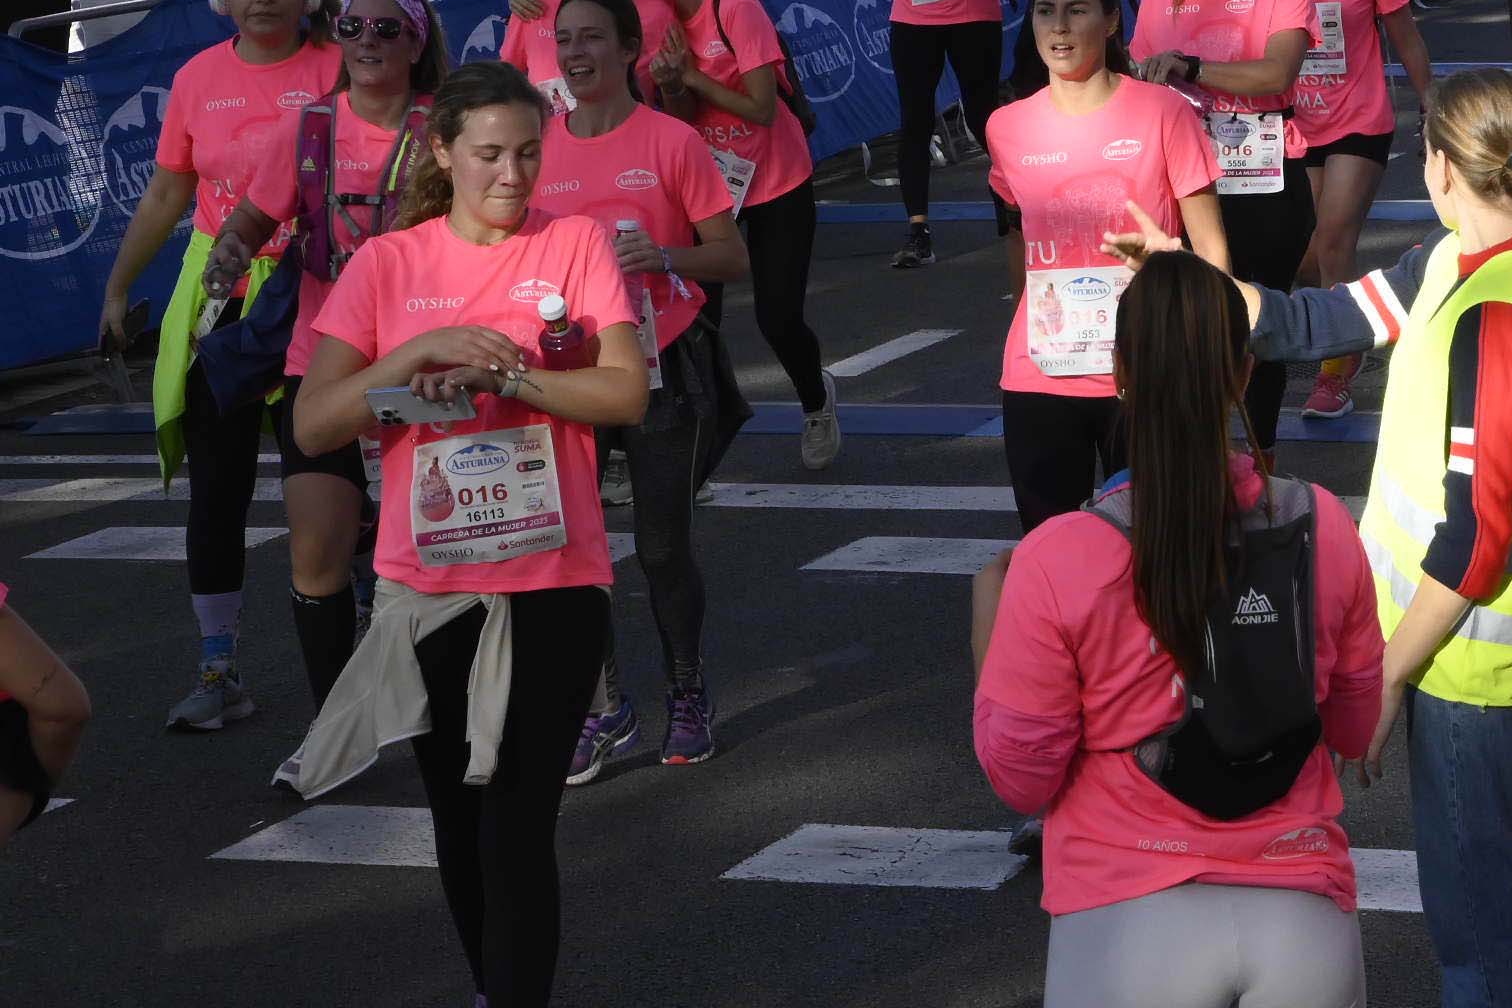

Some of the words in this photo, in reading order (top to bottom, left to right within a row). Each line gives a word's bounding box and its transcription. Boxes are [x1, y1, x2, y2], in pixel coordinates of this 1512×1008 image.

[1165, 4, 1200, 16] OSHO
[206, 97, 246, 111] OYSHO
[1222, 144, 1253, 157] 016
[334, 159, 369, 171] YSHO
[1022, 151, 1068, 166] OYSHO
[1227, 159, 1247, 168] 5556
[405, 296, 465, 313] OYSHO
[514, 442, 542, 454] SUMA
[452, 454, 506, 471] ASTURIANA
[458, 482, 509, 506] 016
[466, 507, 505, 523] 16113
[431, 529, 470, 543] CARRERA
[472, 528, 485, 537] DE
[485, 525, 496, 534] LA
[497, 522, 527, 533] MUJER
[509, 533, 556, 549] Santander
[432, 547, 474, 560] OYSHO
[1231, 613, 1279, 625] AONIJIE
[1152, 838, 1189, 852] AÑOS
